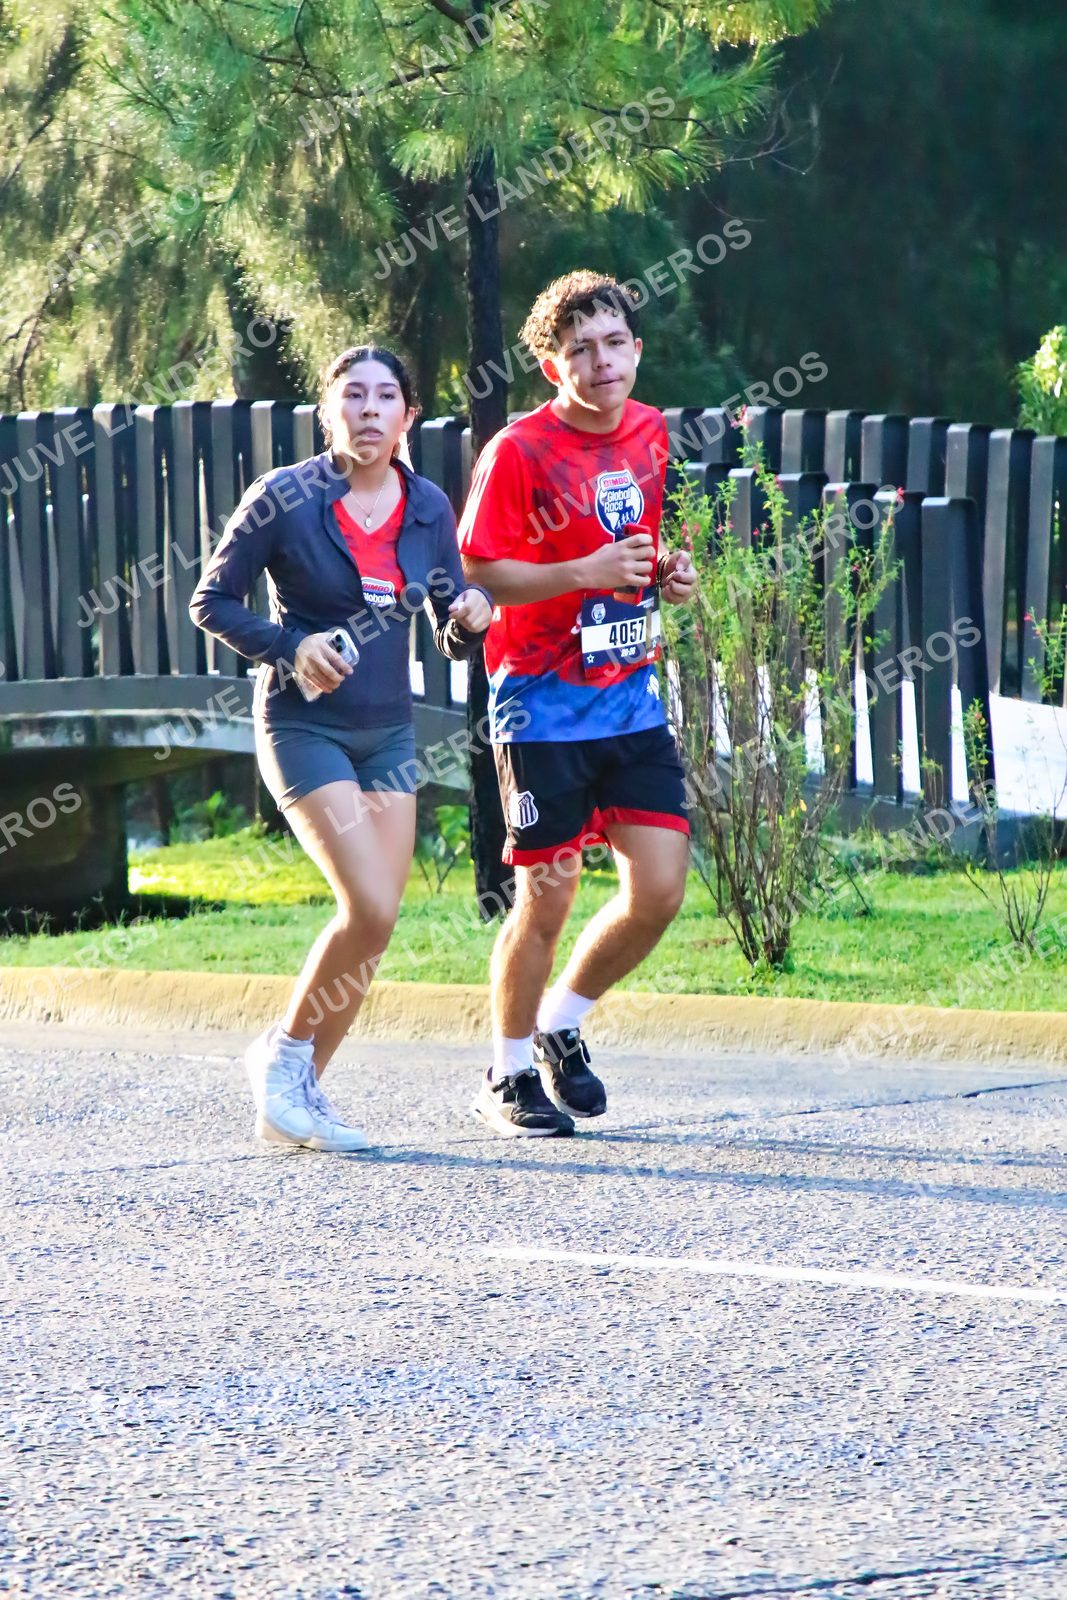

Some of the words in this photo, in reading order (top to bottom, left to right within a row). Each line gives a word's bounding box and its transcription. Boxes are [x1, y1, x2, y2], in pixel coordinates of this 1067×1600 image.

[608, 488, 632, 501] Global
[604, 500, 624, 513] Race
[609, 619, 644, 646] 4057
